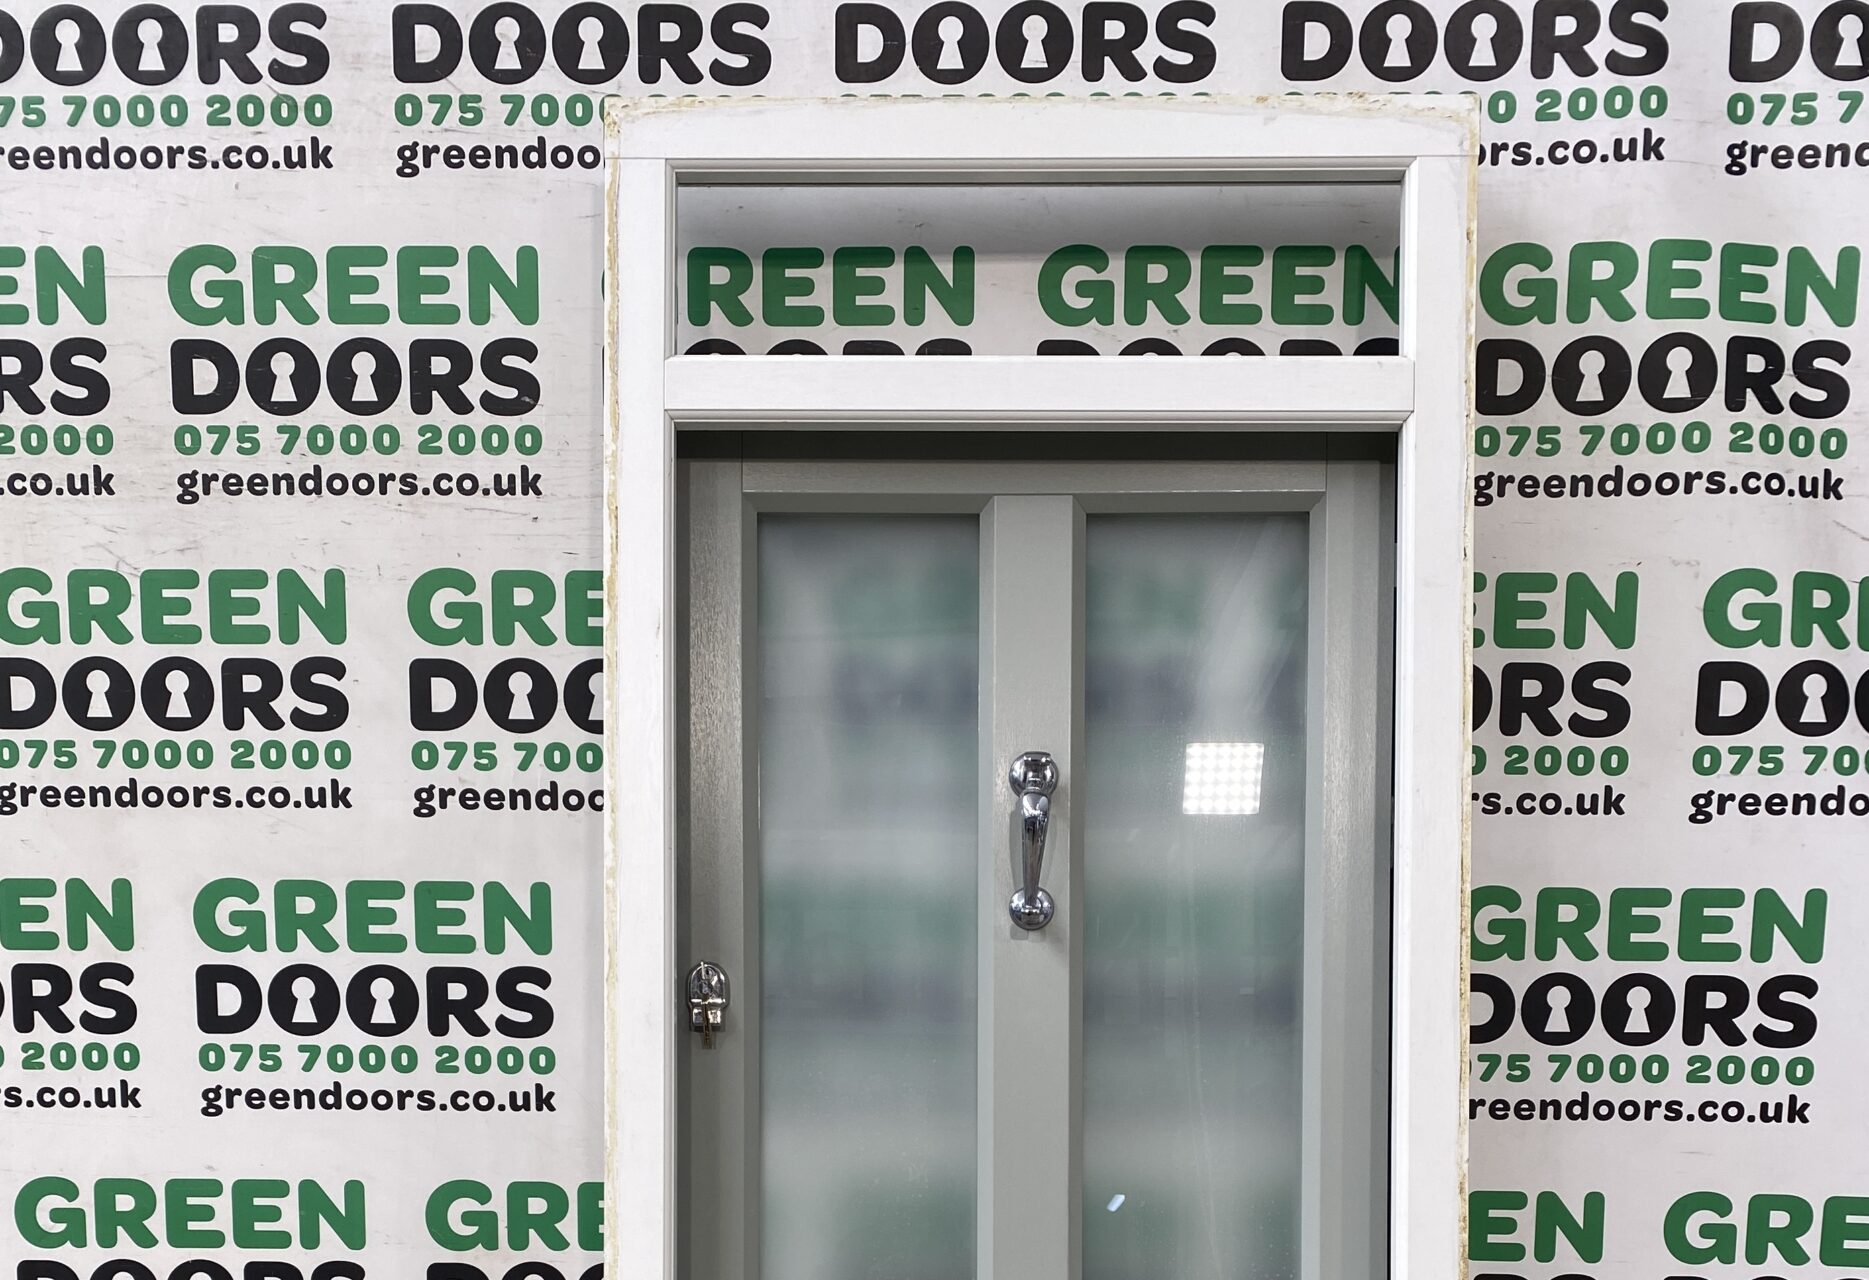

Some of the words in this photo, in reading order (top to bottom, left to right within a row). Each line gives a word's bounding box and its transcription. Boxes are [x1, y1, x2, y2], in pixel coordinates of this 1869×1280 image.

[392, 2, 771, 86] DOORS
[835, 0, 1216, 85] DOORS
[1281, 0, 1668, 82] DOORS
[64, 96, 188, 127] 7000
[208, 95, 332, 126] 2000
[395, 95, 483, 126] 075
[502, 94, 602, 126] 700
[1536, 86, 1667, 121] 2000
[1728, 92, 1817, 125] 075
[0, 137, 333, 170] eendoors.co.uk
[396, 136, 605, 177] greendoo
[168, 245, 539, 325] GREEN
[688, 246, 973, 325] REEN
[1039, 245, 1400, 325] GREEN
[1480, 239, 1860, 326] GREEN
[171, 337, 540, 416] DOORS
[1475, 332, 1851, 423] DOORS
[175, 425, 260, 455] 075
[278, 424, 400, 454] 7000
[419, 424, 542, 454] 2000
[1476, 427, 1559, 455] 075
[1583, 421, 1711, 454] 7000
[1730, 422, 1846, 459] 2000
[177, 465, 542, 504] greendoors.co.uk
[1474, 465, 1843, 506] greendoors.co.uk
[0, 567, 347, 645] GREEN
[1474, 572, 1638, 648] EN
[1704, 569, 1869, 651] GR
[0, 656, 349, 732] DOORS
[1472, 661, 1631, 738] RS
[1695, 660, 1869, 737] DO
[0, 739, 76, 768] 075
[93, 740, 213, 768] 7000
[232, 740, 351, 769] 2000
[412, 740, 496, 772] 075
[514, 742, 602, 772] 700
[1505, 746, 1628, 775] 2000
[1693, 746, 1782, 776] 075
[1804, 746, 1869, 775] 70
[0, 778, 352, 815] greendoors.co.uk
[1689, 785, 1869, 824] greendo
[193, 878, 552, 955] GREEN
[1472, 886, 1828, 963] GREEN
[0, 962, 137, 1034] RS
[196, 964, 554, 1038] DOORS
[1470, 972, 1818, 1048] DOORS
[21, 1042, 140, 1071] 2000
[199, 1043, 282, 1072] 075
[298, 1044, 418, 1073] 7000
[436, 1045, 555, 1075] 2000
[1479, 1054, 1528, 1081] 75
[1550, 1055, 1669, 1083] 7000
[1687, 1056, 1814, 1085] 2000
[0, 1080, 141, 1108] s.co.uk
[201, 1081, 555, 1117] greendoors.co.uk
[1469, 1092, 1810, 1123] reendoors.co.uk
[15, 1176, 366, 1250] GREEN
[1664, 1192, 1869, 1268] GRE
